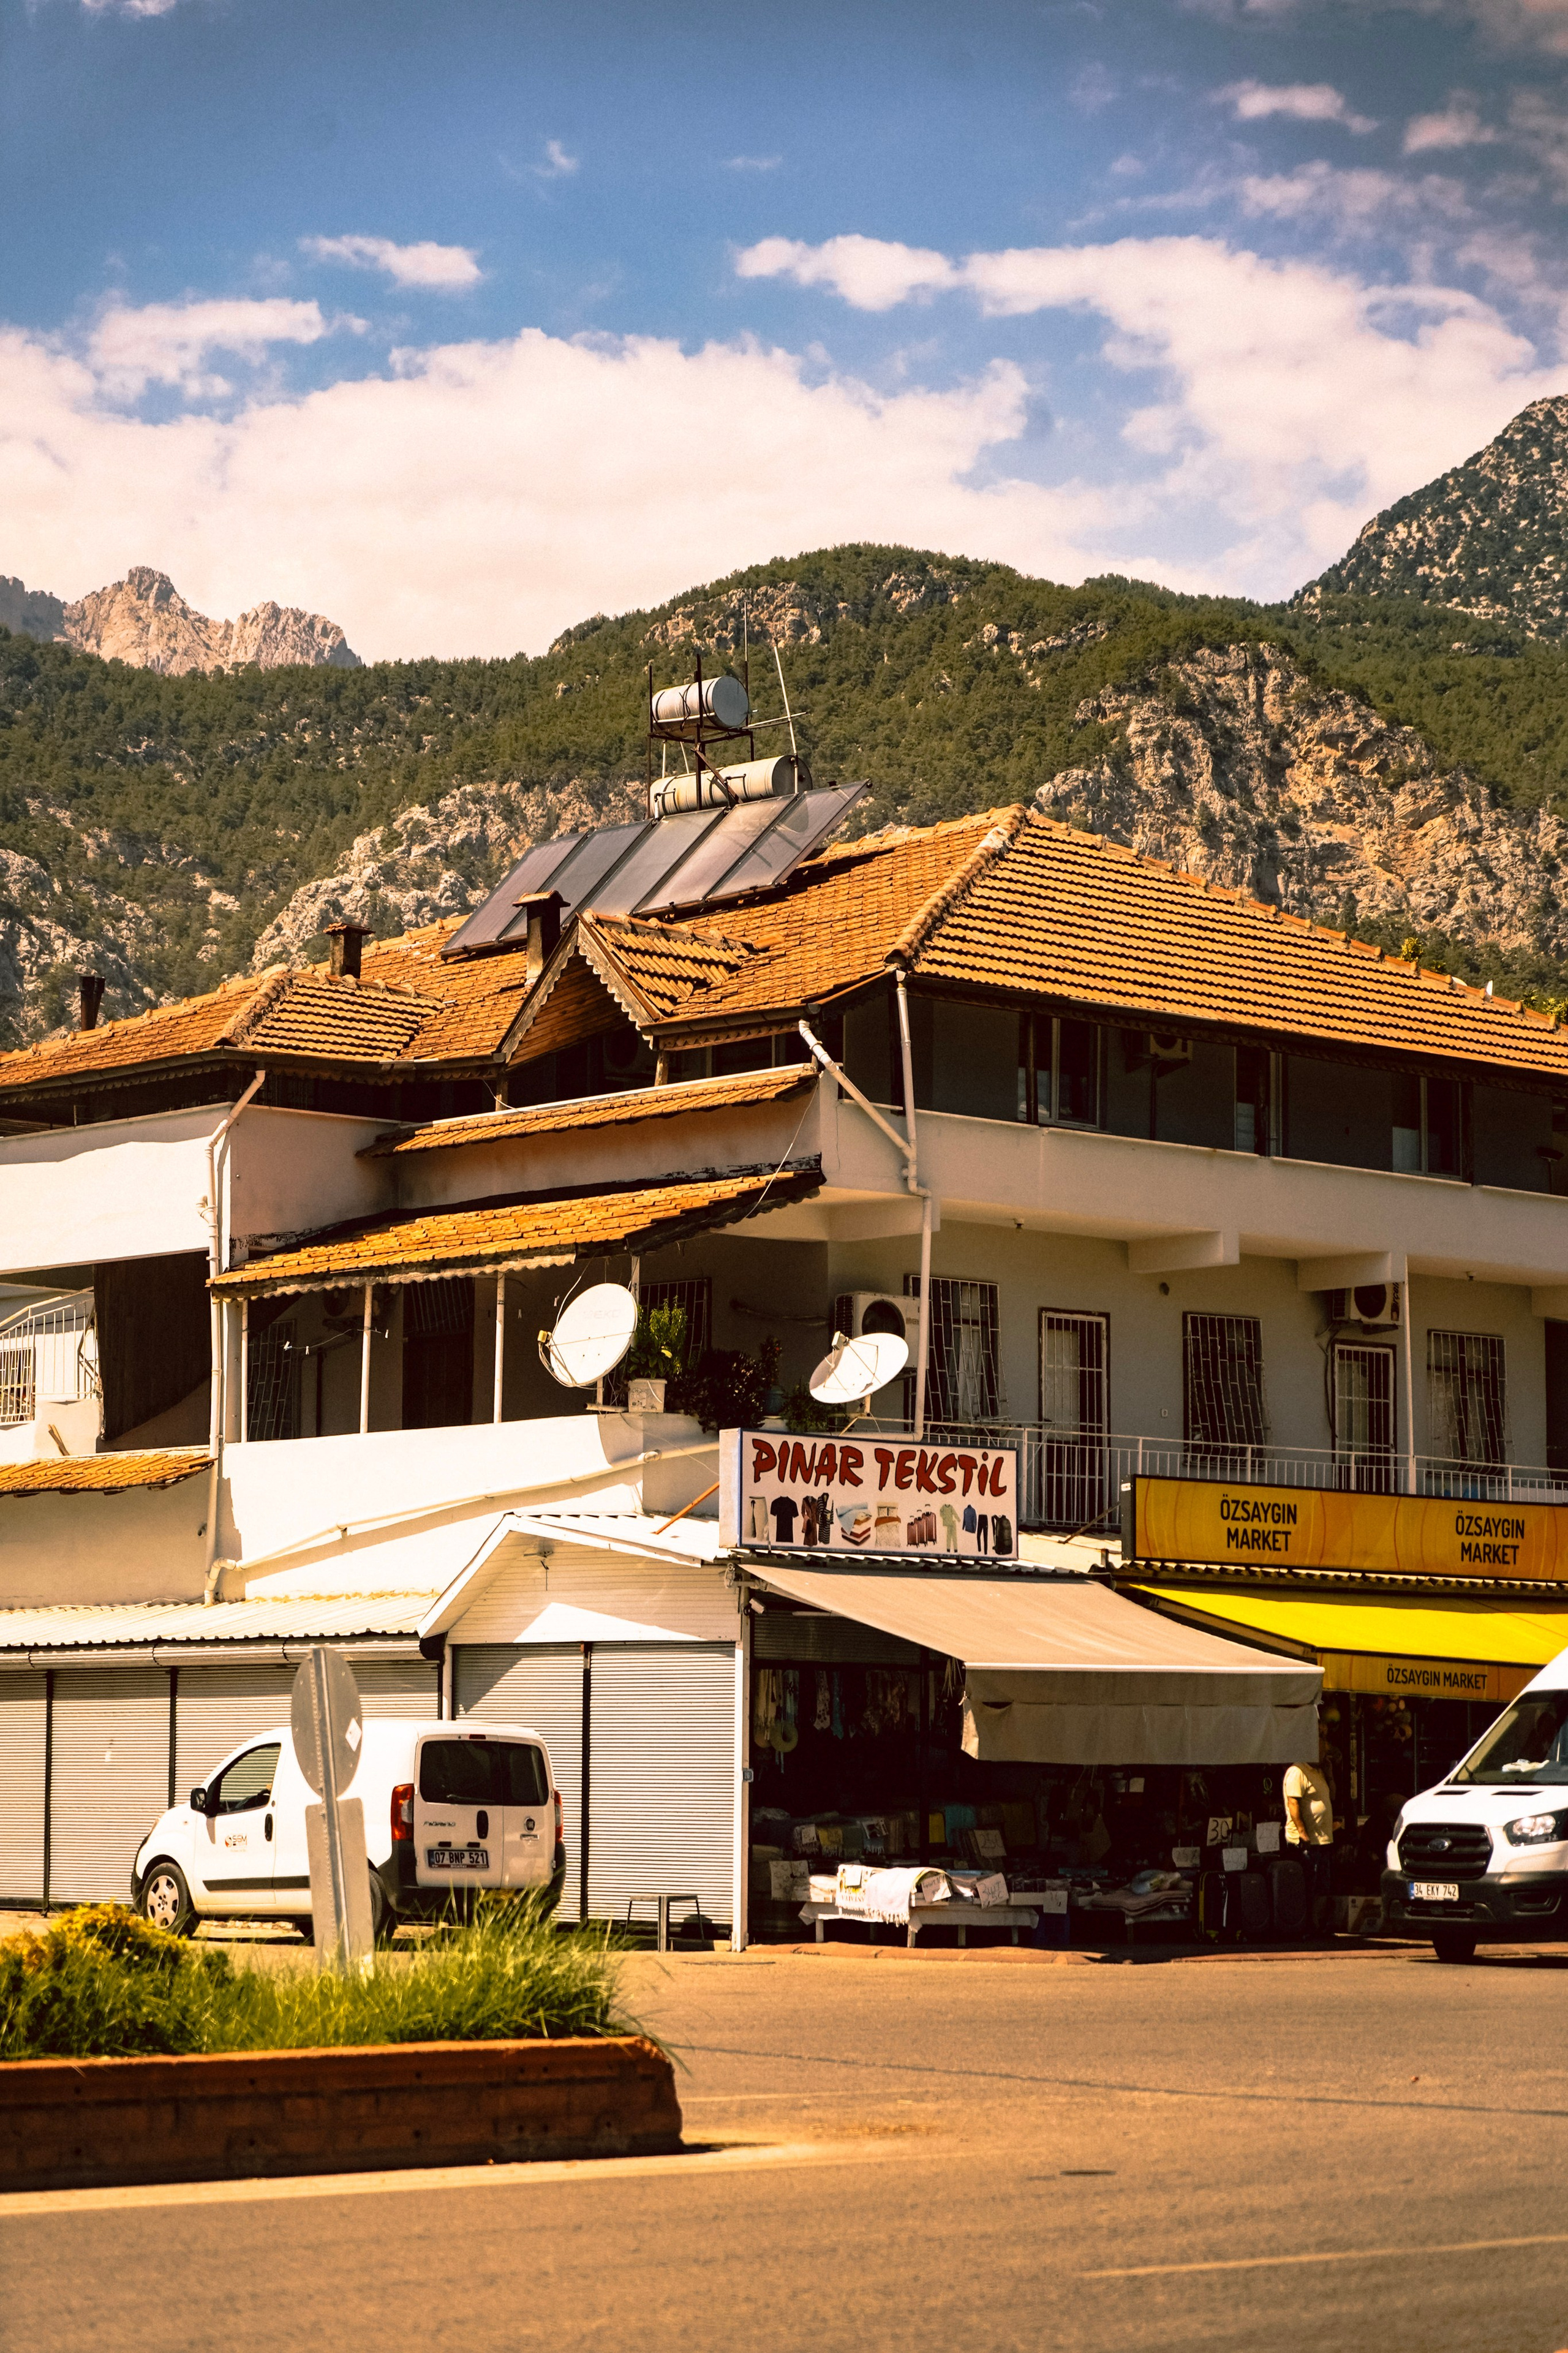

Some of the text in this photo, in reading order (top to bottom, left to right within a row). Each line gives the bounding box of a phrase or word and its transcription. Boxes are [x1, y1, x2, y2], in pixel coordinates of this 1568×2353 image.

[752, 1438, 864, 1487] PINAR
[1220, 1494, 1298, 1525] ÖZSAYGIN
[1455, 1510, 1525, 1539] ÖZSAYGIN
[1227, 1527, 1292, 1552] MARKET
[1461, 1541, 1520, 1565] MARKET
[1387, 1664, 1488, 1691] ÖZSAYGIN MARKET
[434, 1852, 485, 1864] 07 BNP 521
[1414, 1884, 1457, 1897] 34 EKY 742
